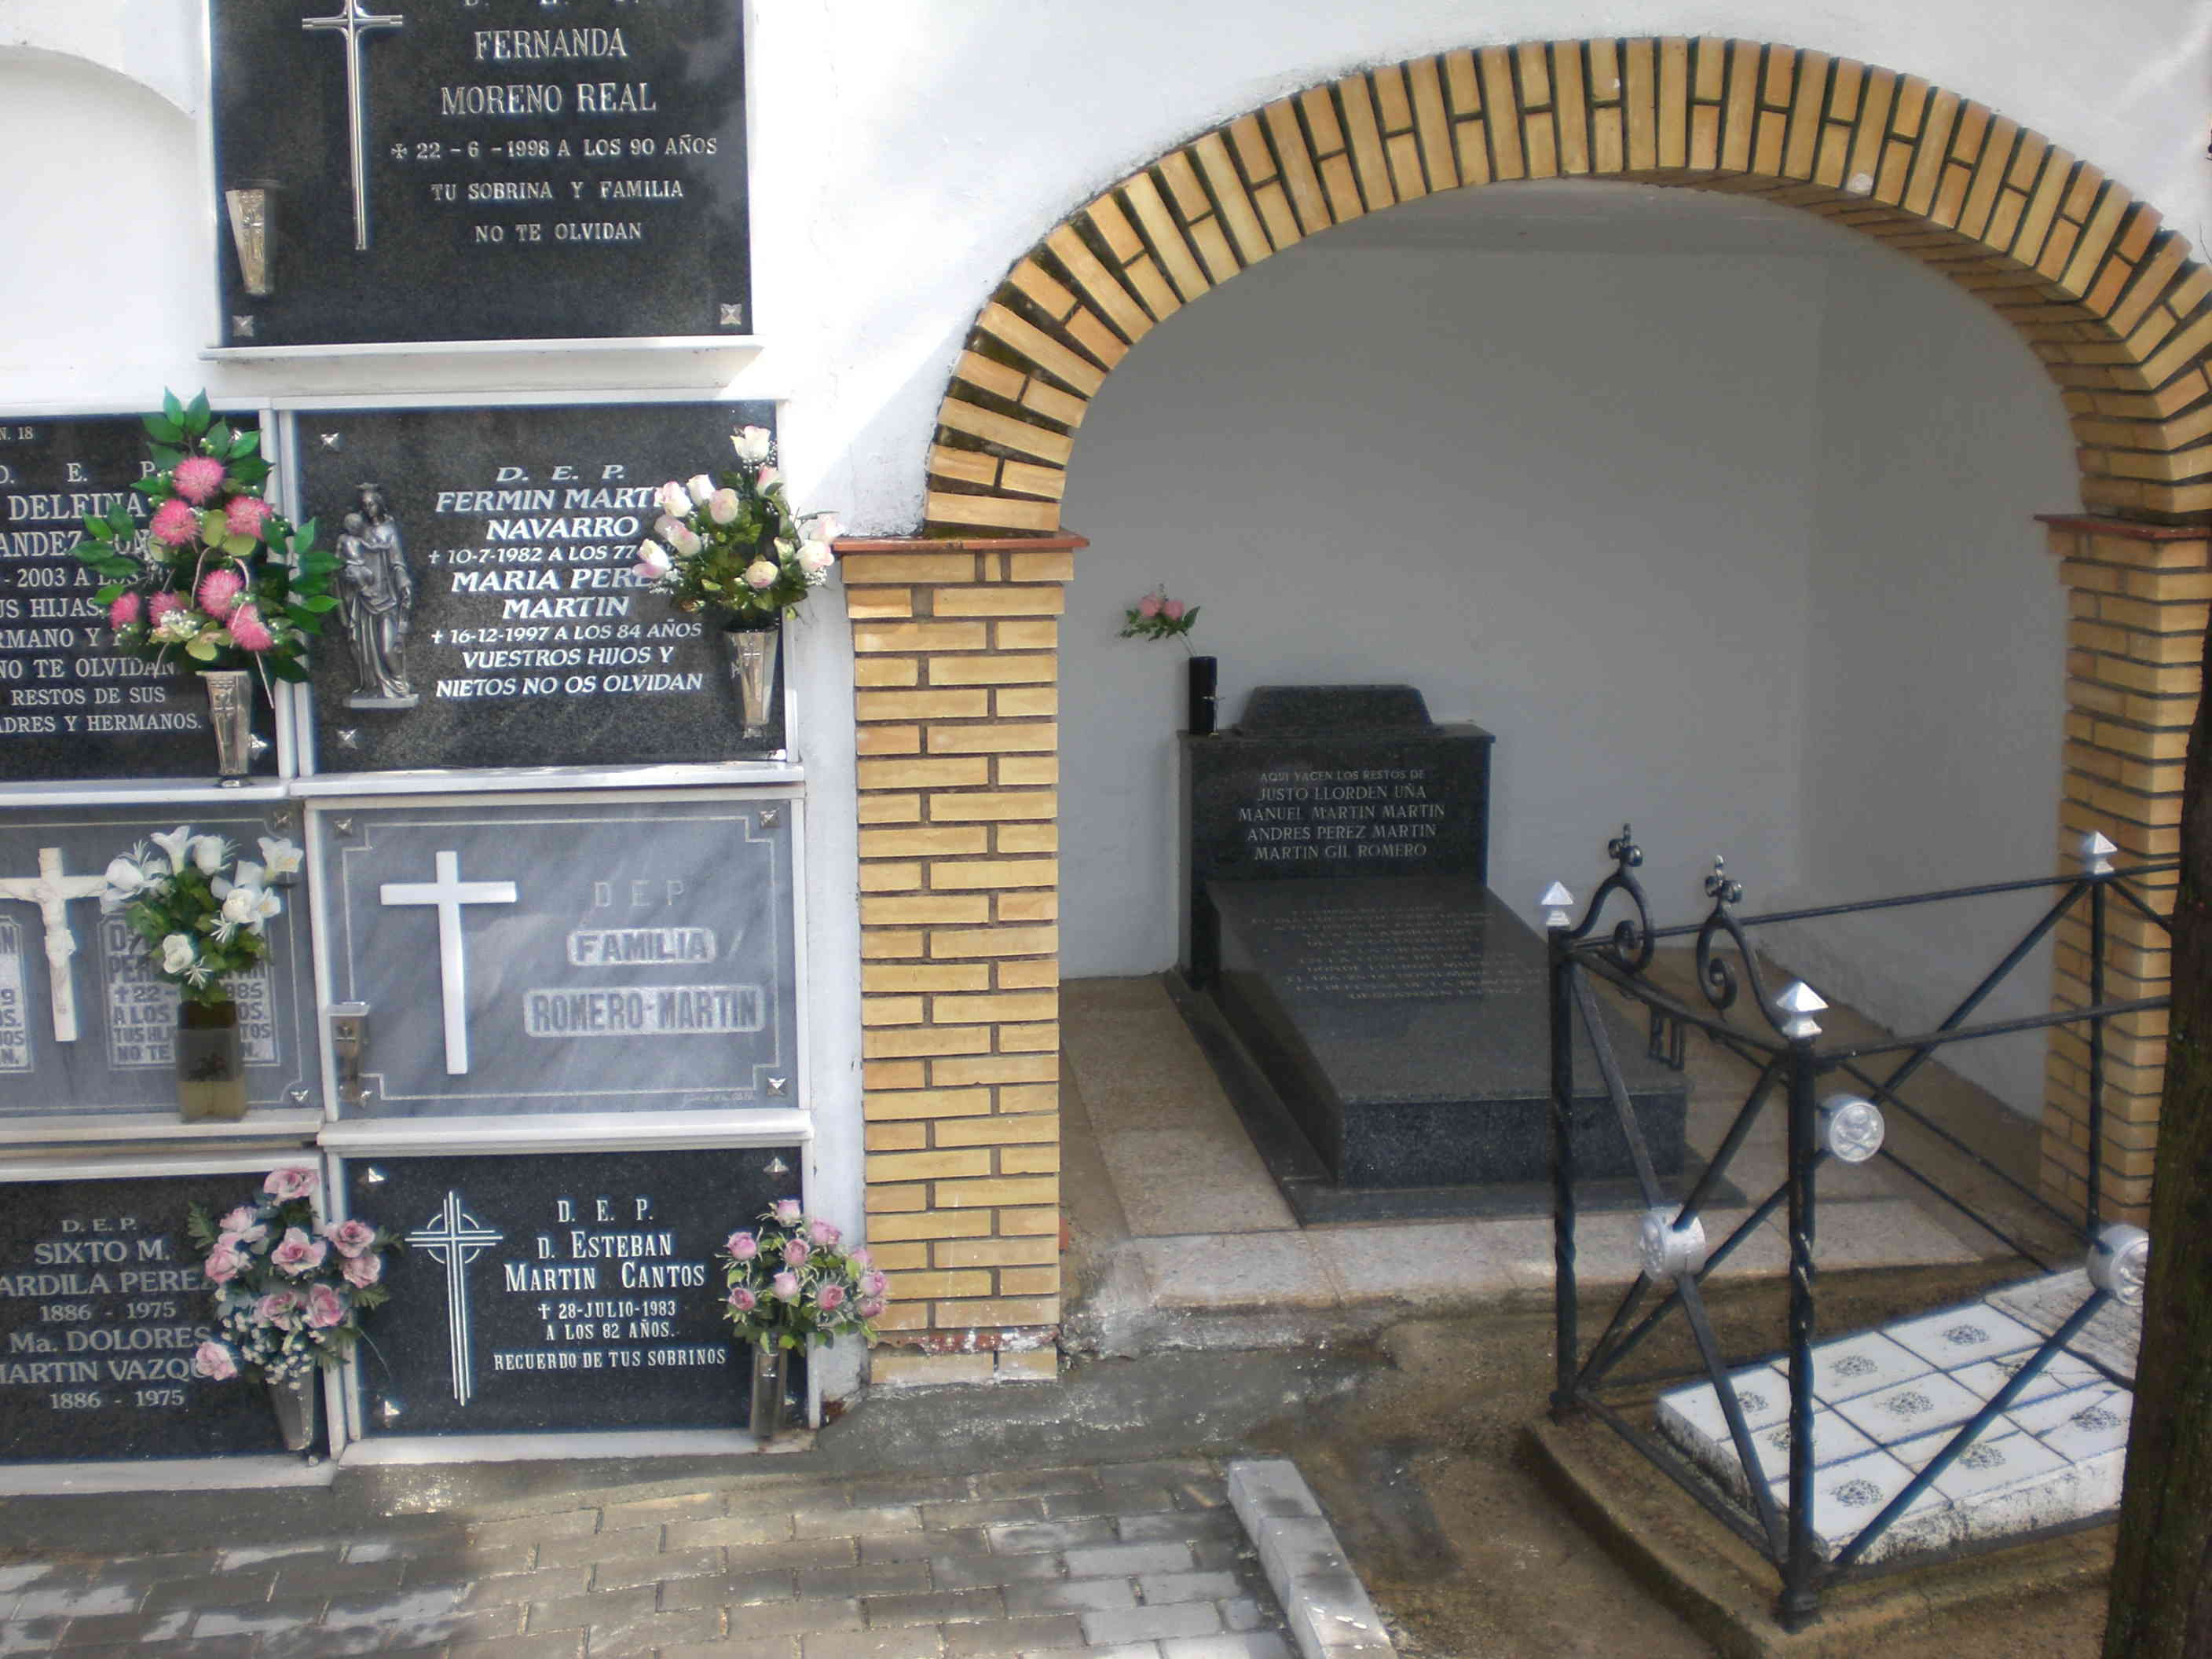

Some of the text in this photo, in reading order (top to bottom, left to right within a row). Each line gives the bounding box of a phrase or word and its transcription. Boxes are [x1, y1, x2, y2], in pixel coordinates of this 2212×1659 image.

[474, 27, 628, 60] FERNANDA
[441, 82, 656, 115] MORENO REAL
[416, 142, 441, 159] 22
[557, 139, 571, 156] A
[584, 137, 621, 156] LOS
[631, 137, 655, 156] 90
[664, 134, 718, 155] AÑOS
[432, 179, 684, 202] TU SOBRINA Y FAMILIA
[474, 222, 642, 243] NO TE OLVIDAN
[18, 427, 34, 440] 18
[66, 463, 88, 482] E.
[496, 464, 624, 482] D. E. P.
[7, 493, 146, 521] DELFINA
[435, 489, 554, 512] FERMIN
[485, 516, 639, 540] NAVARRO
[448, 544, 637, 564] 10-7-1982 A LOS 77
[17, 568, 66, 588] 2003
[74, 567, 90, 586] A
[452, 569, 559, 592] MARIA
[503, 596, 629, 619] MARTIN
[85, 628, 102, 646] Y
[451, 618, 702, 644] 16-12-1997 A LOS 84 AÑOS
[462, 646, 674, 668] VUESTROS HIJOS Y
[33, 658, 65, 679] TE
[75, 657, 175, 678] OLVIDAN
[10, 687, 167, 705] RESTOS DE SUS
[436, 673, 703, 698] NIETOS NO OS OLVIDAN
[64, 716, 79, 732] Y
[86, 713, 202, 732] HERMANOS.
[1337, 771, 1359, 781] LOS
[1363, 769, 1407, 781] RESTOS
[1258, 786, 1308, 801] JUSTO
[1238, 804, 1446, 822] MANUEL MARTIN MARTIN
[1247, 823, 1437, 842] ANDRES PEREZ MARTIN
[1254, 843, 1427, 861] MARTIN GIL ROMERO
[576, 931, 707, 962] FAMILIA
[131, 1005, 170, 1024] LOS
[147, 1045, 170, 1060] TE
[557, 1198, 654, 1223] D. E. P.
[34, 1239, 170, 1265] SIXTO M.
[537, 1237, 555, 1258] D.
[40, 1304, 93, 1323] 1886
[126, 1302, 177, 1320] 1975
[558, 1300, 676, 1320] 28-JULIO-1983
[67, 1327, 211, 1352] DOLORES
[546, 1320, 675, 1341] A LOS 82 AÑOS.
[494, 1348, 727, 1371] RECUERDO DE TUS SOBRINOS
[49, 1392, 101, 1410] 1886
[134, 1390, 185, 1407] 1975
